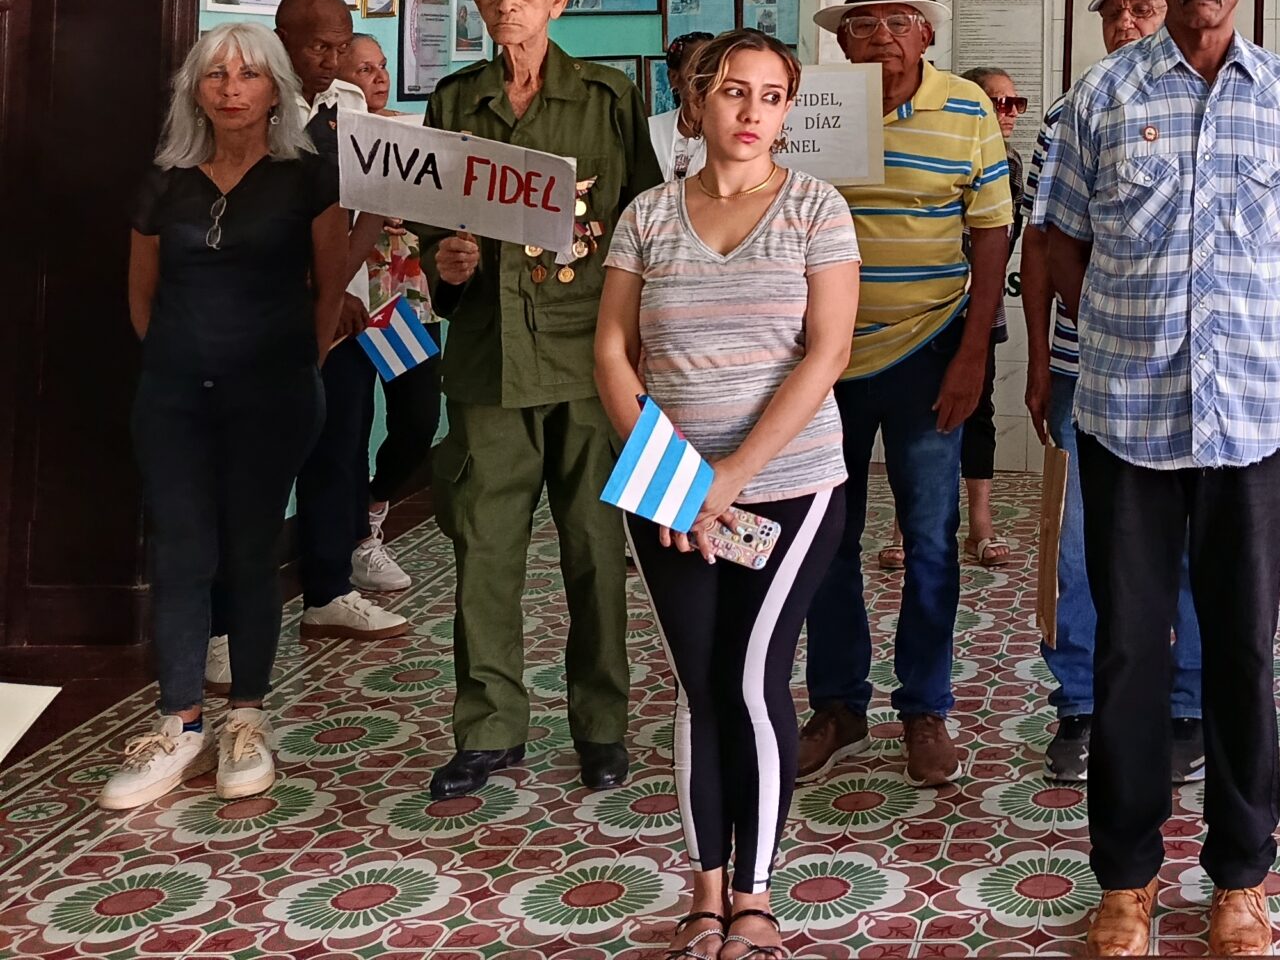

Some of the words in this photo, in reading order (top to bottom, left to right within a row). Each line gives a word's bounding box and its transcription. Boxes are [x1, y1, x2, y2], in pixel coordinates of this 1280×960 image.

[805, 113, 841, 130] DÍAZ
[350, 134, 442, 190] VIVA
[463, 155, 561, 213] FIDEL
